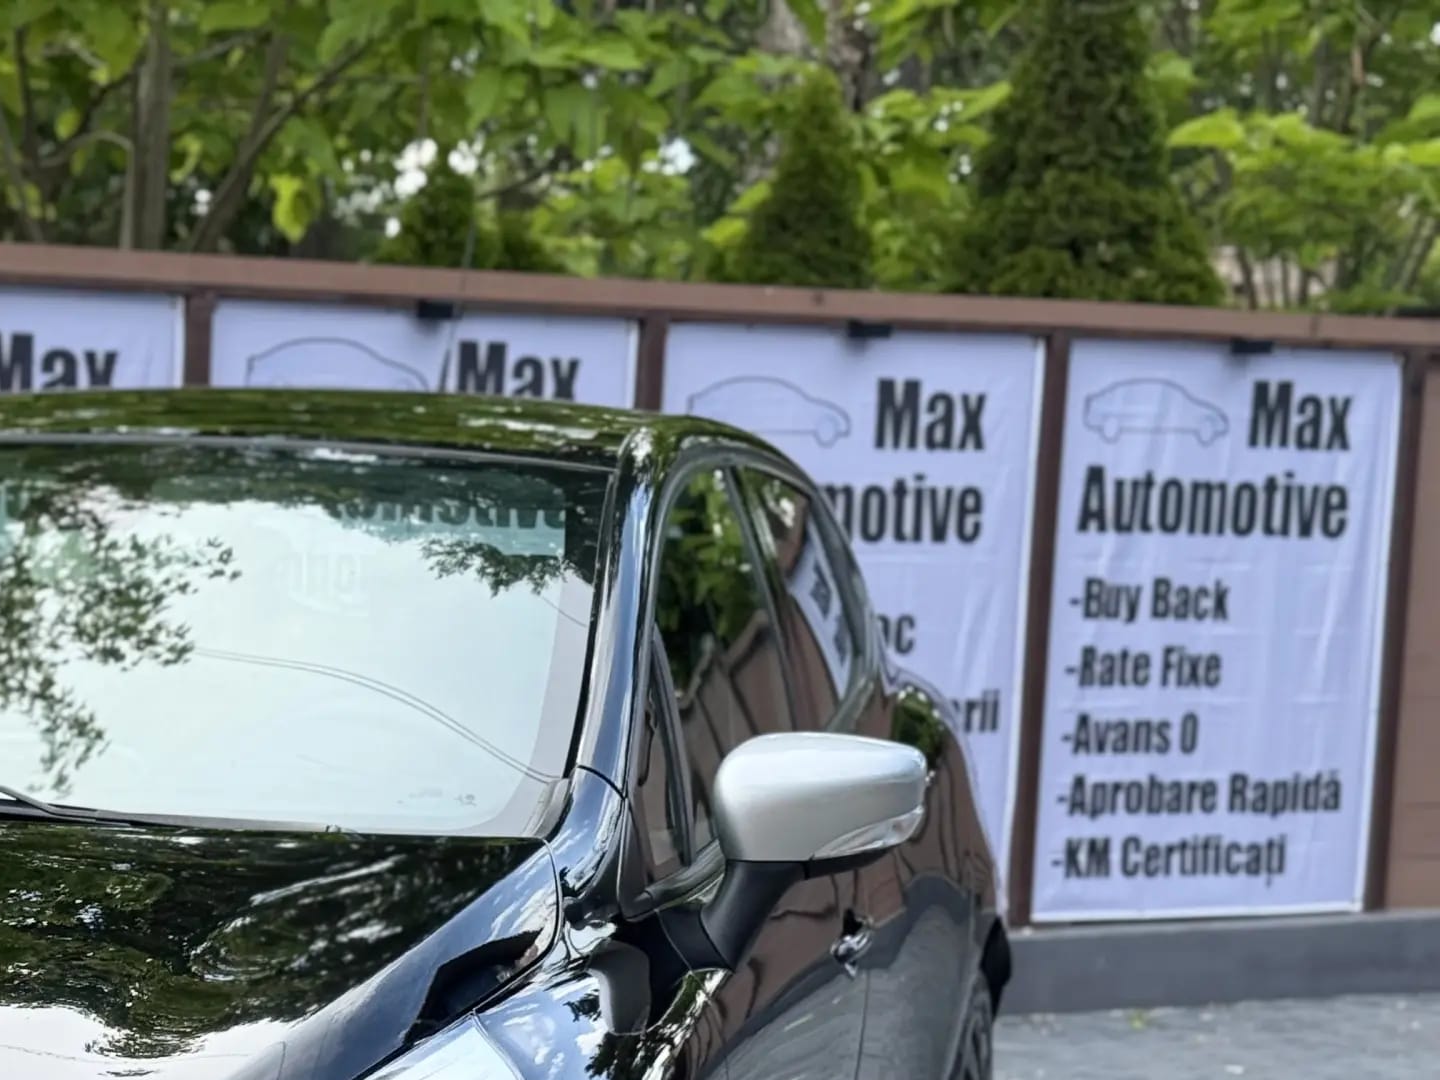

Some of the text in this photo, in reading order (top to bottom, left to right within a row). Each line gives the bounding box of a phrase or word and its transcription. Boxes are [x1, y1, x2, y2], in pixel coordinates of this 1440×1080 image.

[456, 337, 581, 400] Max
[873, 377, 987, 452] Max
[1247, 379, 1353, 452] Max
[1076, 464, 1349, 540] Automotive
[1067, 577, 1230, 624] -Buy Back
[1063, 645, 1223, 689] -Rate Fixe
[1059, 711, 1200, 756] -Avans 0
